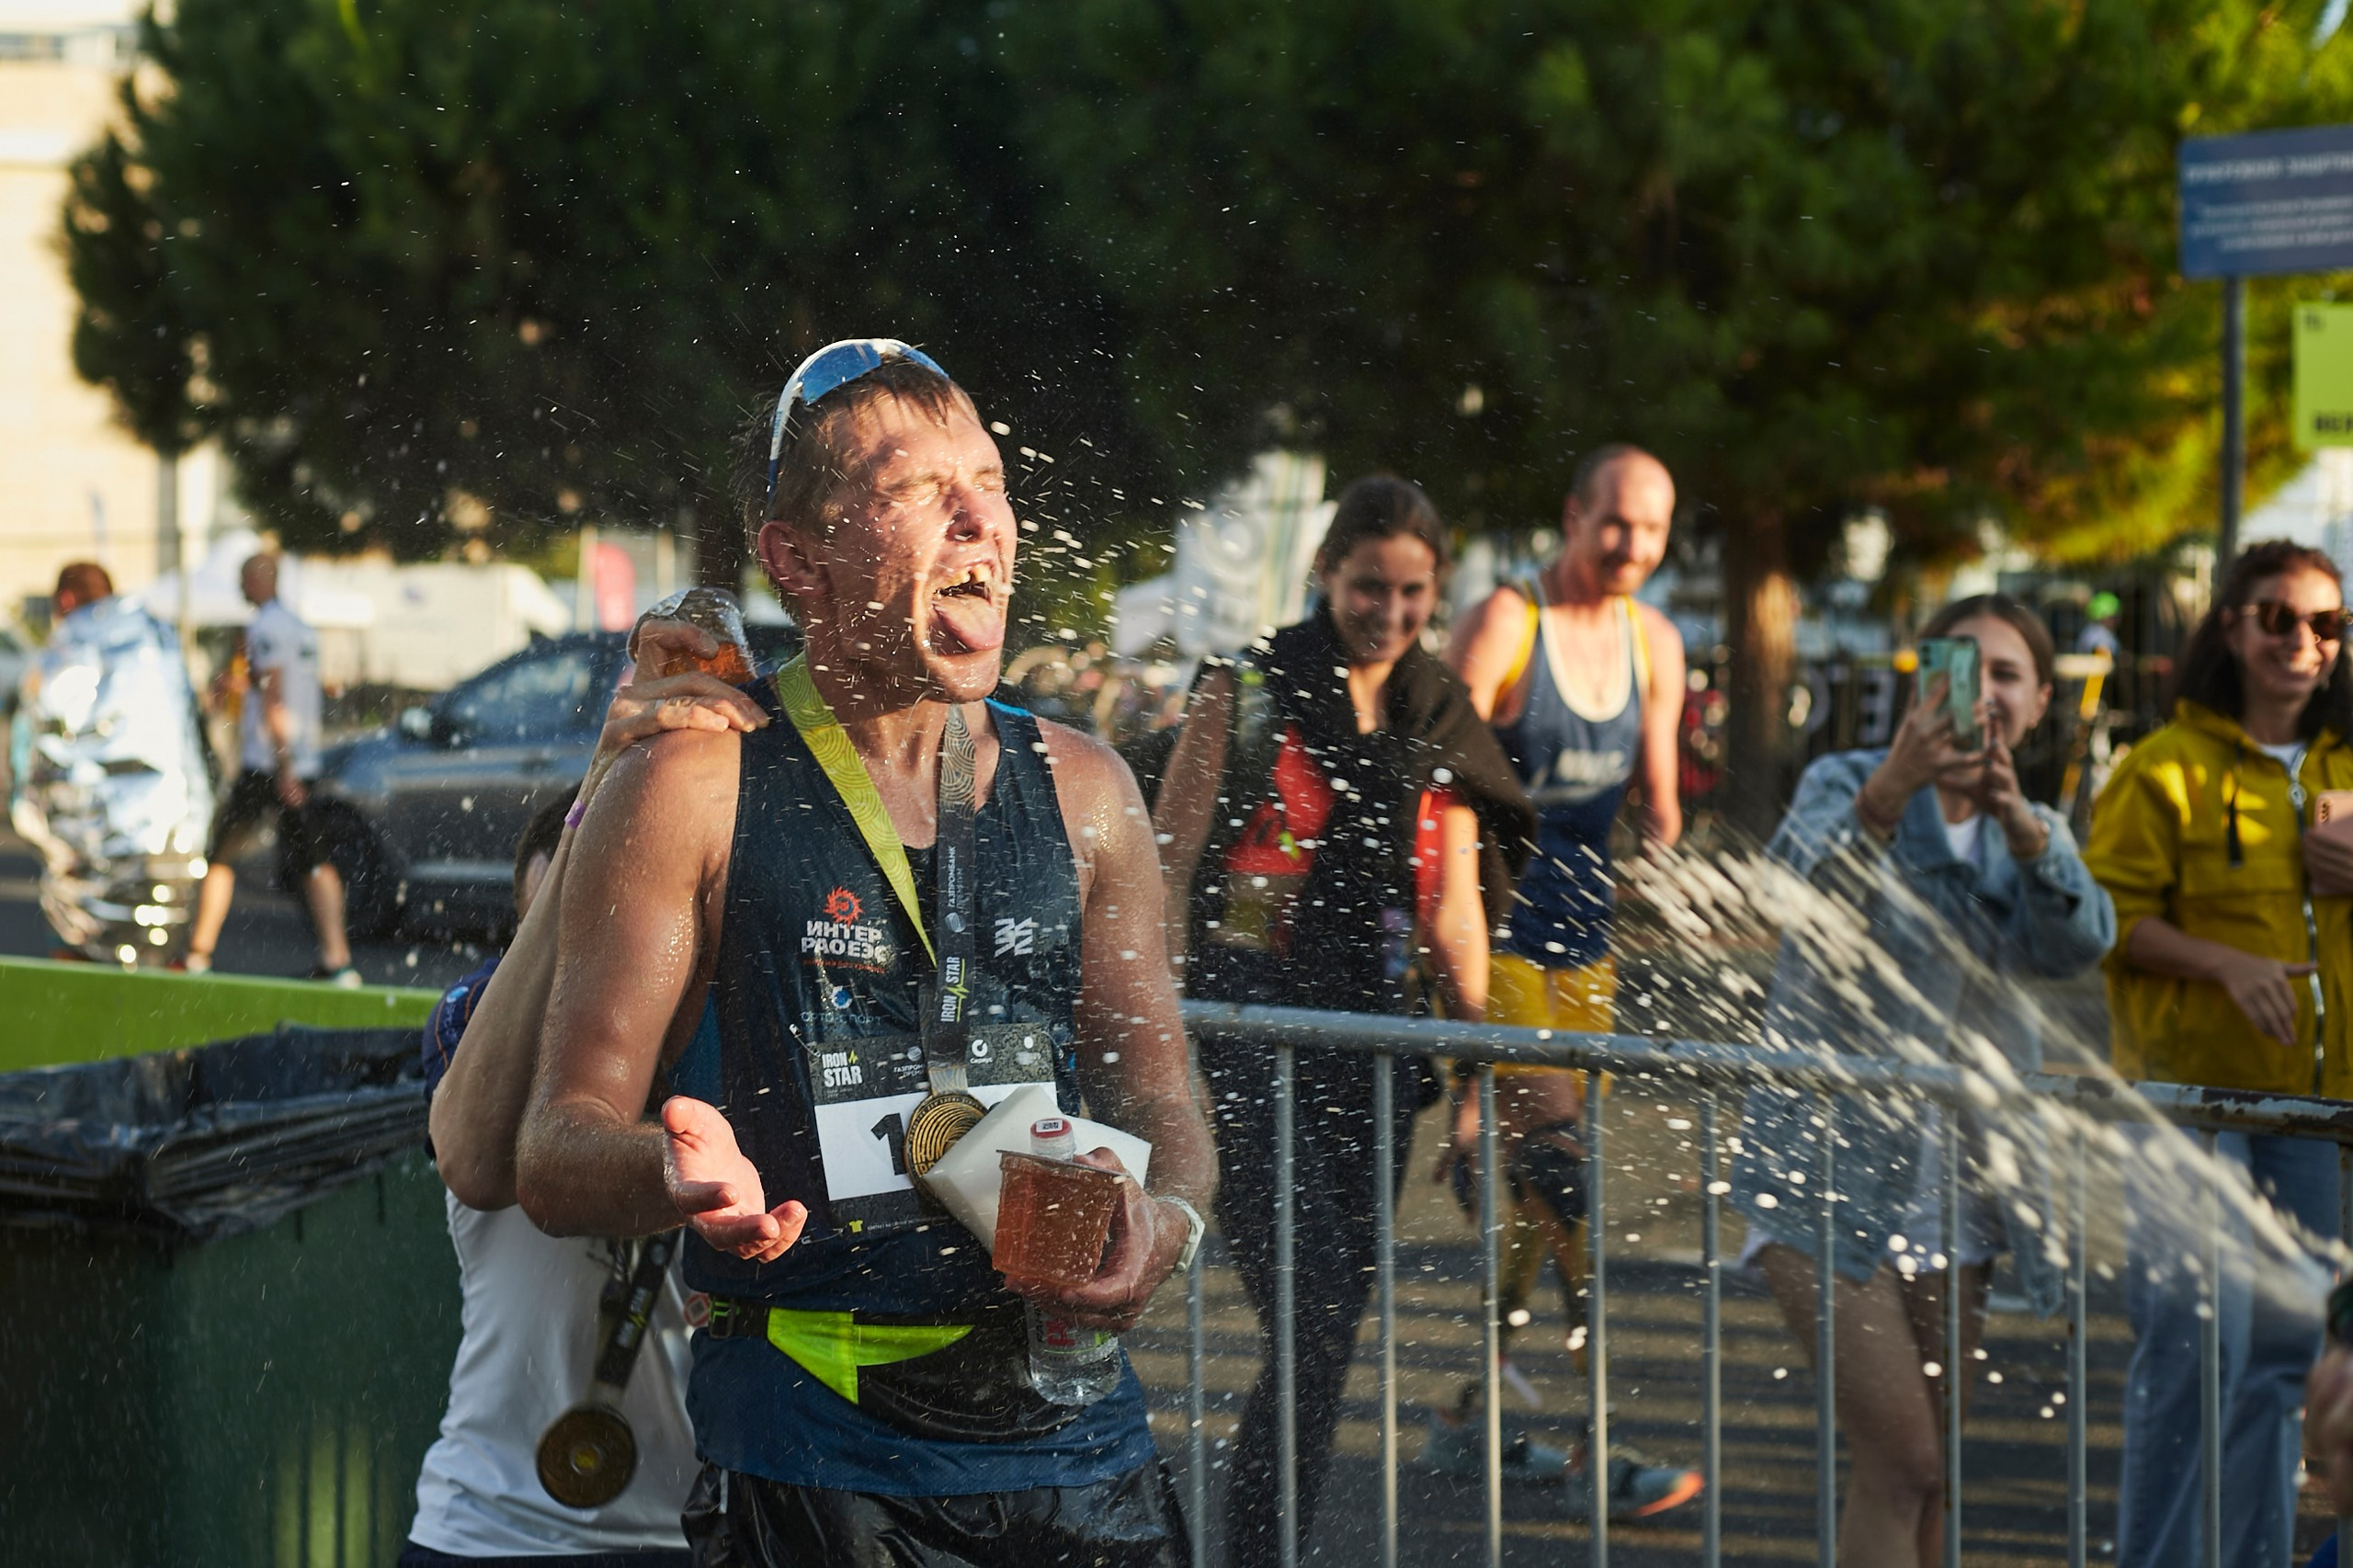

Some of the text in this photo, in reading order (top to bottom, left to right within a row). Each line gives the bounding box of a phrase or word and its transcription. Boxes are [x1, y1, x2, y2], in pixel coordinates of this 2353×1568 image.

[948, 846, 956, 908] ГАЗПРОМБАНК
[806, 920, 882, 944] ИНТЕР
[940, 956, 961, 1022] IRON STAR
[822, 1051, 848, 1068] IRON
[824, 1065, 863, 1087] STAR
